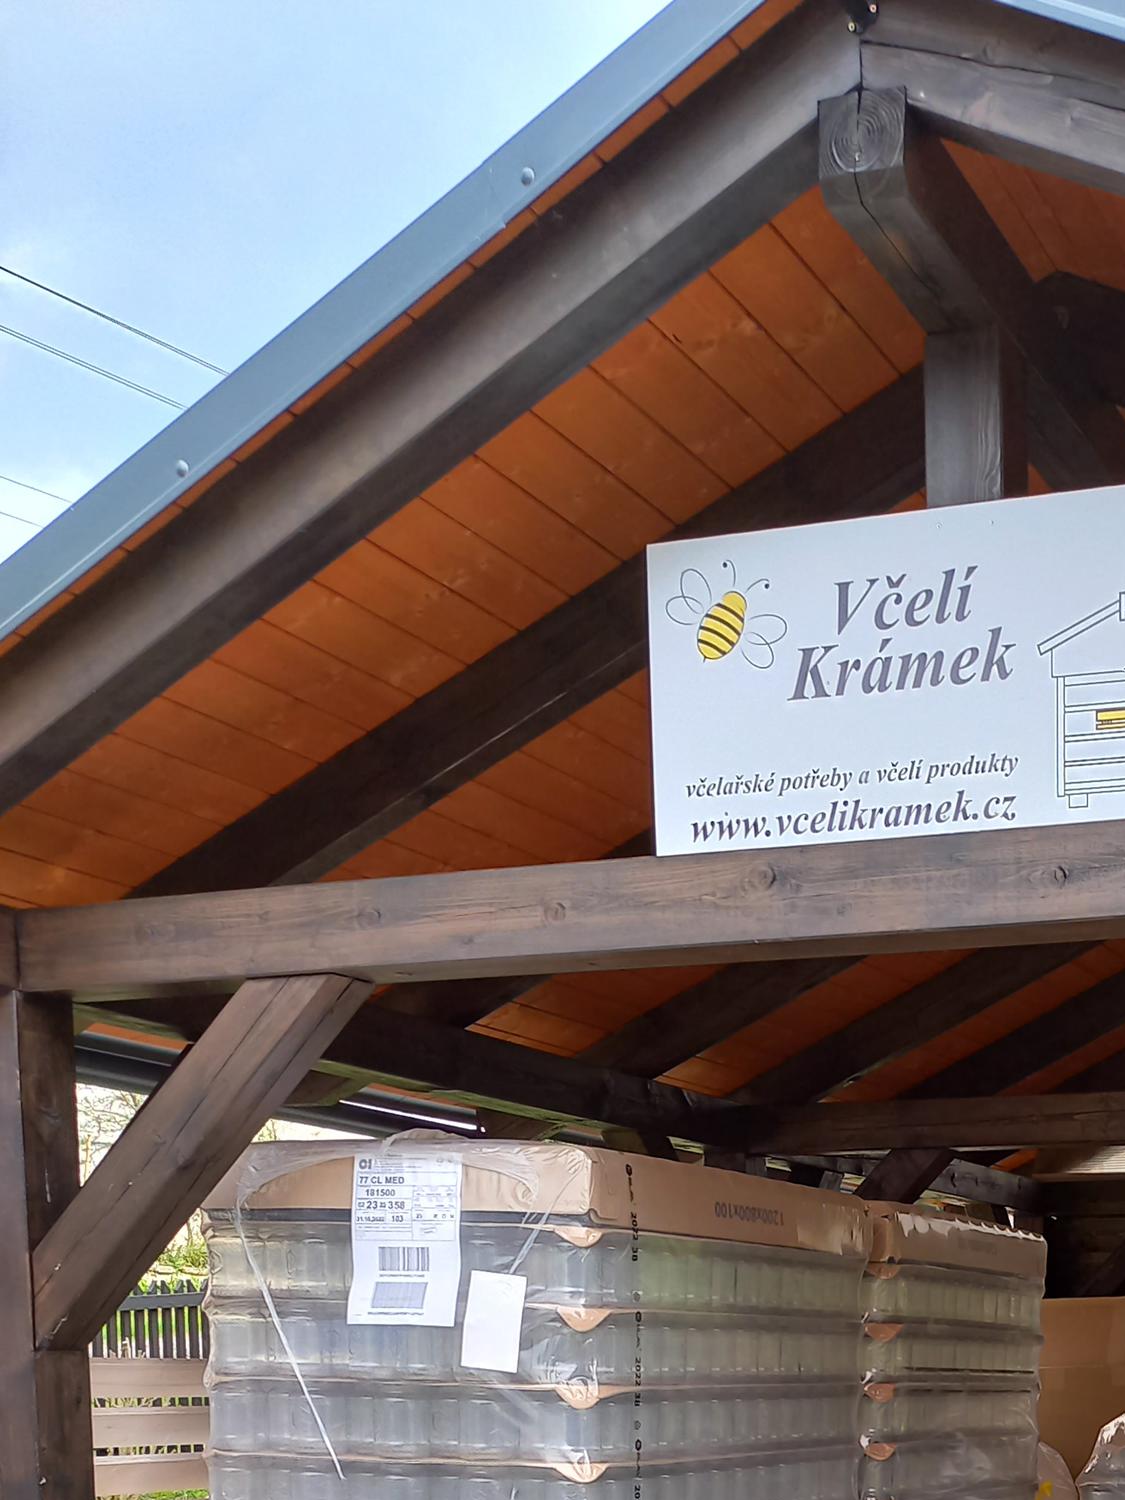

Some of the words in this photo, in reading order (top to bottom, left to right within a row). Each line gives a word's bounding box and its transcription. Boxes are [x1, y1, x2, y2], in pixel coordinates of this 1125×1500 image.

[834, 565, 978, 635] Včelí
[787, 626, 1016, 701] Krámek
[686, 772, 776, 798] včelařské
[778, 767, 852, 797] potřeby
[859, 769, 870, 784] a
[877, 759, 923, 783] včelí
[925, 753, 1018, 784] produkty
[691, 789, 1016, 843] www.vcelikramek.cz
[359, 1176, 369, 1184] 77
[370, 1176, 383, 1184] CL
[384, 1176, 405, 1184] MED
[365, 1188, 396, 1197] 181500
[366, 1200, 378, 1210] 23
